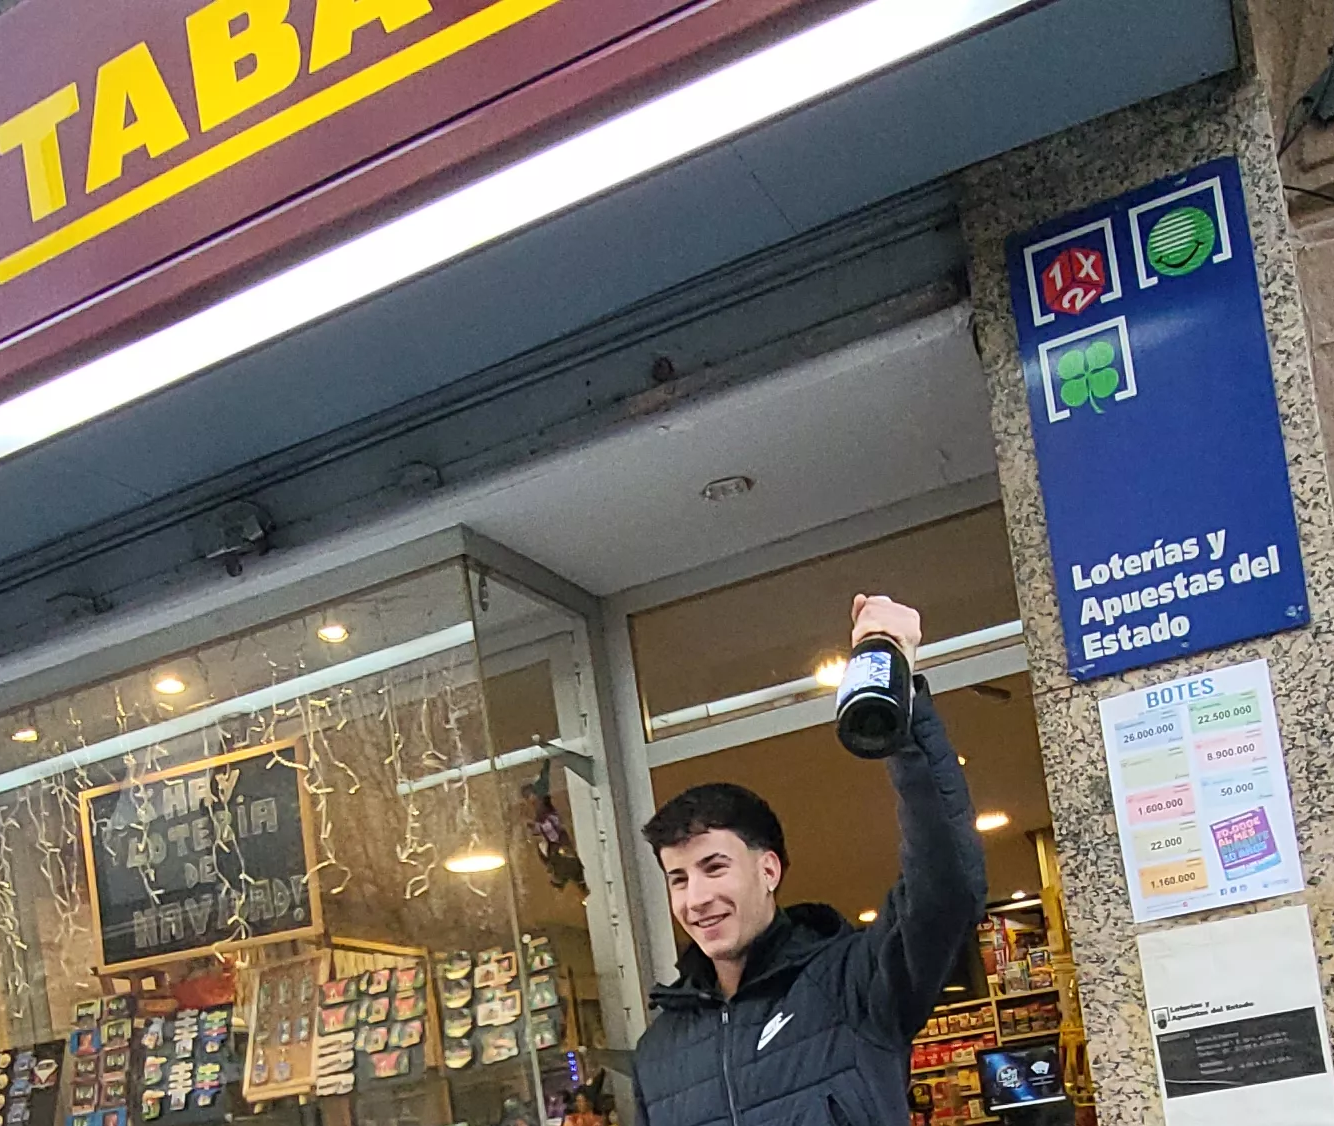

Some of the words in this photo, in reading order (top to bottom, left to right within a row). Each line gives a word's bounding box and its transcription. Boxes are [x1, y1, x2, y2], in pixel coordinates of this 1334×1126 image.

[1071, 536, 1200, 591] Loterías
[1205, 528, 1226, 561] y
[1080, 567, 1225, 626] Apuestas
[1229, 544, 1281, 584] del
[1082, 612, 1191, 661] Estado
[1145, 677, 1216, 709] BOTES
